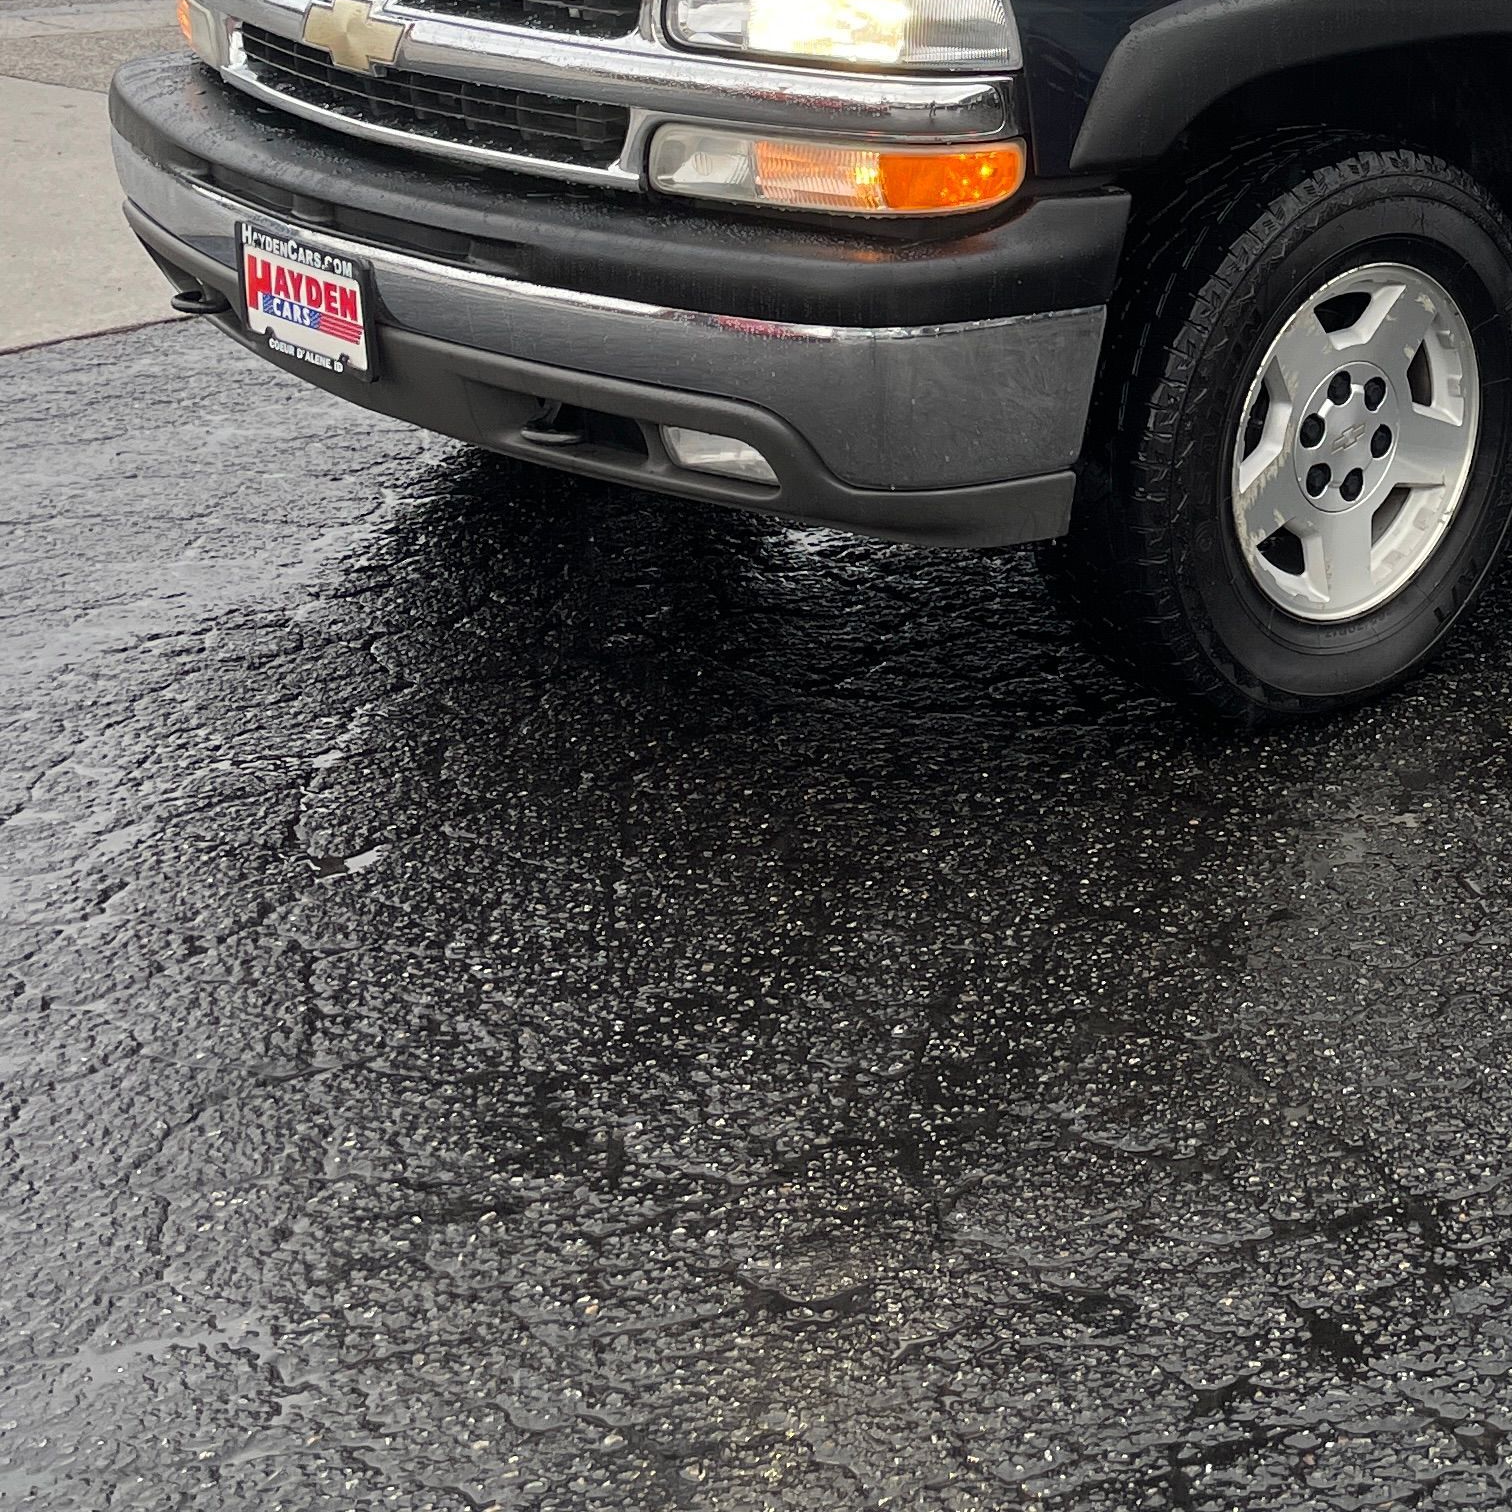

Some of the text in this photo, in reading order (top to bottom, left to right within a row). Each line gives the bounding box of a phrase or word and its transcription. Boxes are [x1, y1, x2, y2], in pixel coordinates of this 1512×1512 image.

[247, 254, 359, 322] HAYDEN
[272, 298, 311, 326] CARS
[268, 338, 295, 356] COEUR
